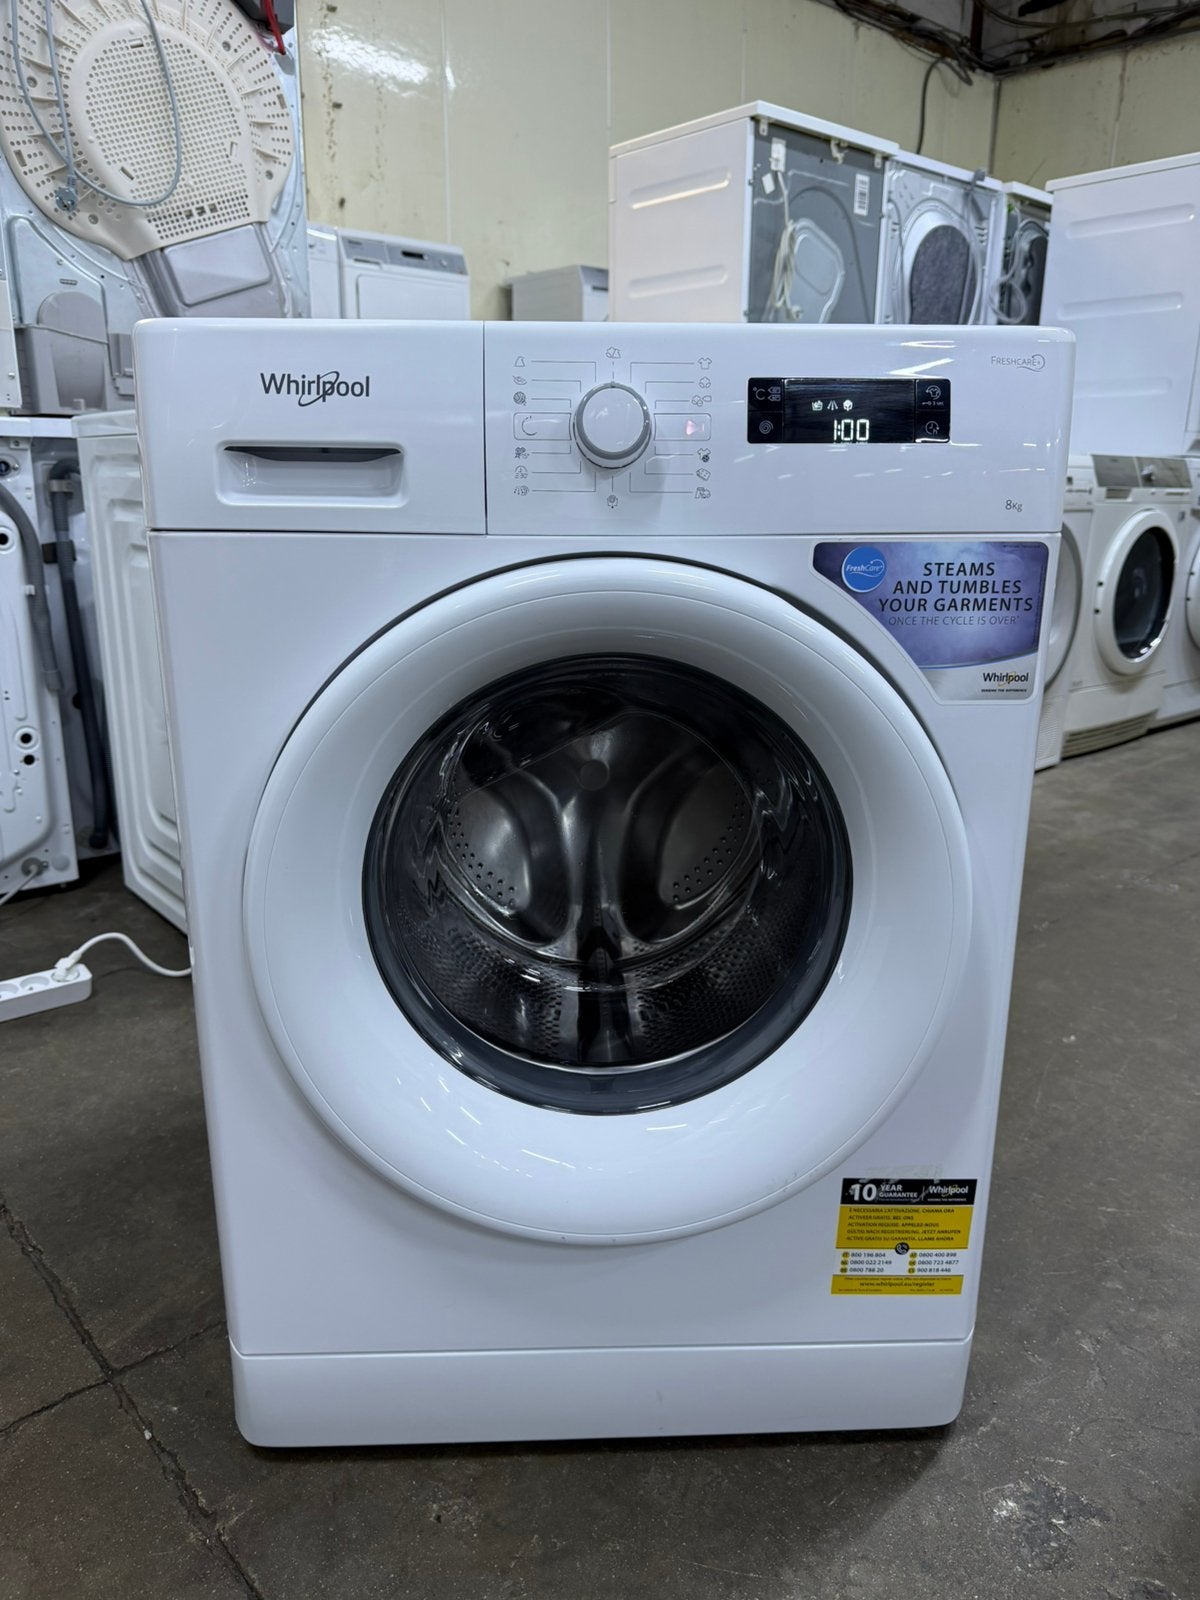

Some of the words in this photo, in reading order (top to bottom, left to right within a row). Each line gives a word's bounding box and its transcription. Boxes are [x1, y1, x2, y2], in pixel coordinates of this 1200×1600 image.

[260, 371, 370, 406] Whirlpool
[833, 419, 870, 441] 1:00
[923, 562, 996, 577] STEAMS
[893, 580, 933, 595] AND
[938, 580, 1022, 594] TUMBLES
[879, 598, 928, 612] YOUR
[933, 597, 1034, 612] GARMENTS
[888, 616, 918, 626] ONCE
[920, 616, 940, 626] THE
[942, 616, 975, 625] CYCLE
[977, 616, 987, 625] IS
[982, 671, 1029, 687] Whirlpool
[850, 1183, 877, 1201] 10
[880, 1184, 903, 1192] YEAR
[928, 1184, 969, 1197] Whirlpool
